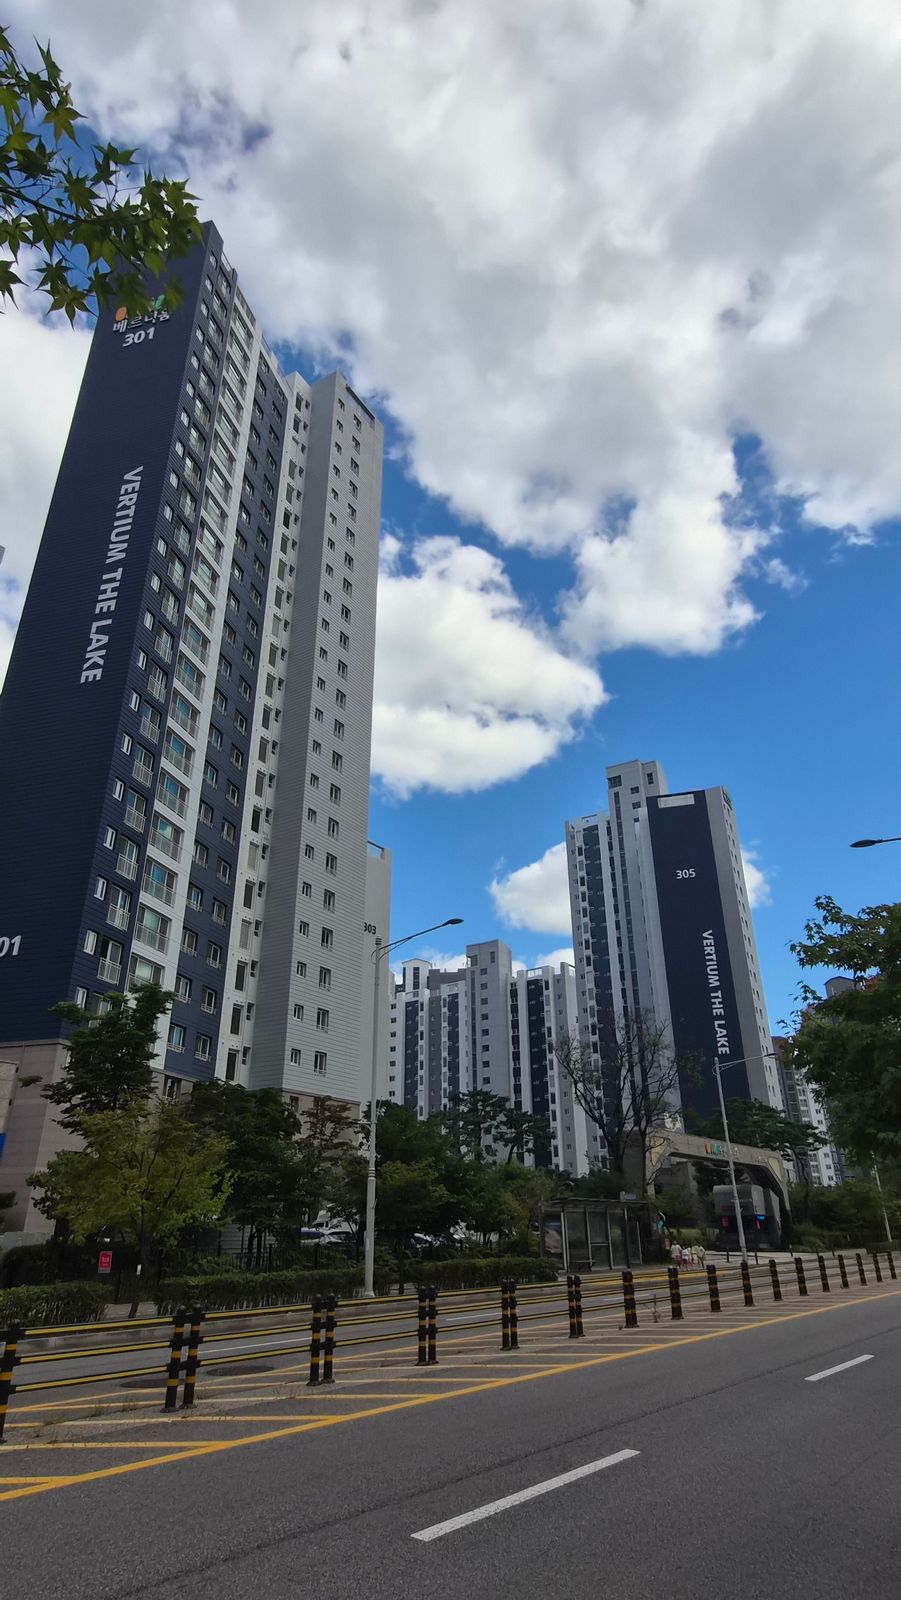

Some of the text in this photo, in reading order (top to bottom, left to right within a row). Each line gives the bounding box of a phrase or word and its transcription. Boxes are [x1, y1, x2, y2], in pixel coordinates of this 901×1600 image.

[122, 326, 155, 347] 301
[80, 465, 144, 684] VERTIUM THE LAKE
[675, 868, 696, 879] 305
[702, 929, 730, 1055] VERTIUM THE LAKE
